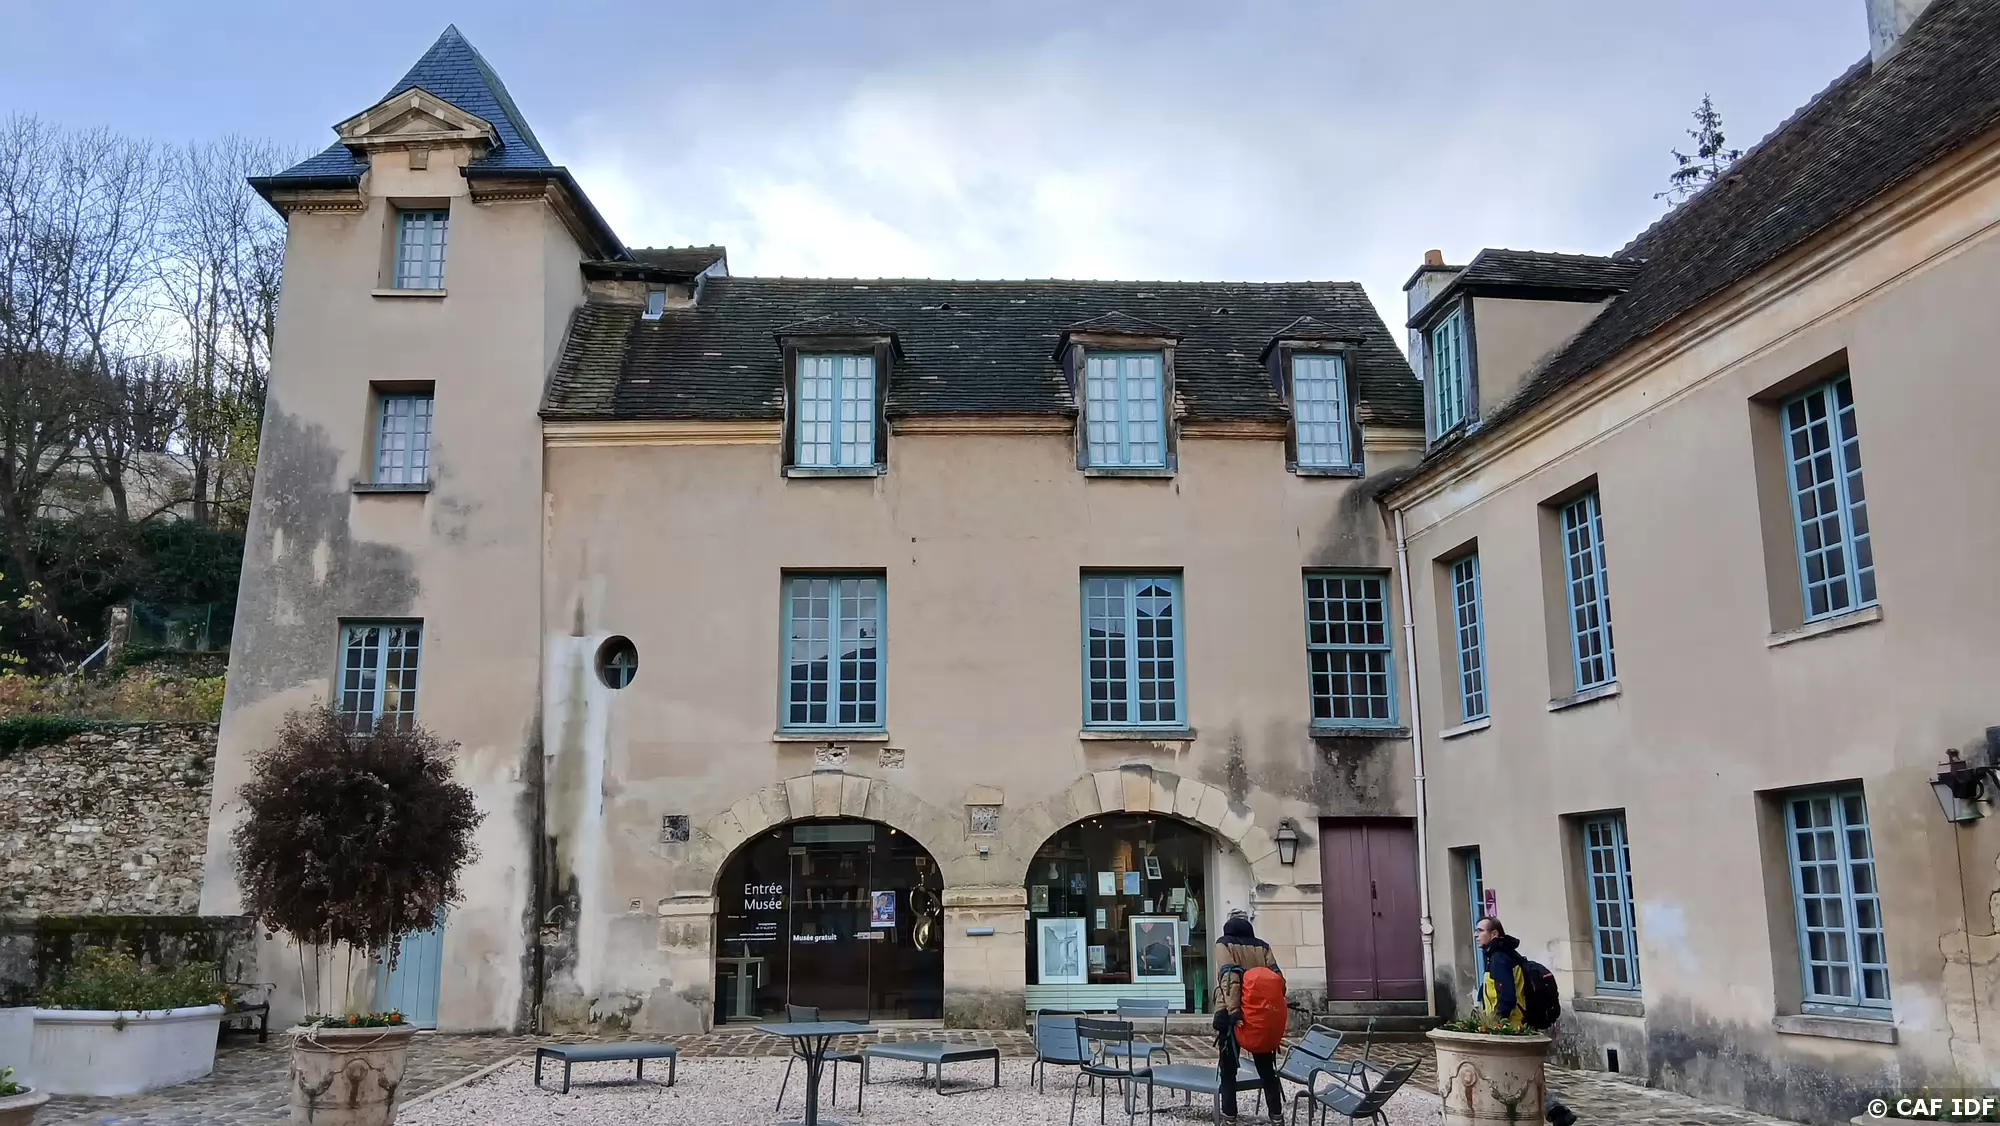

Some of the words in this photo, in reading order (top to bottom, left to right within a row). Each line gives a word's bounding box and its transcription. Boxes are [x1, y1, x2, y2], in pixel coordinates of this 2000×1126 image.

[744, 881, 783, 895] Entrée
[744, 897, 782, 910] Musée
[792, 933, 813, 941] Musée
[814, 932, 837, 943] gratuit
